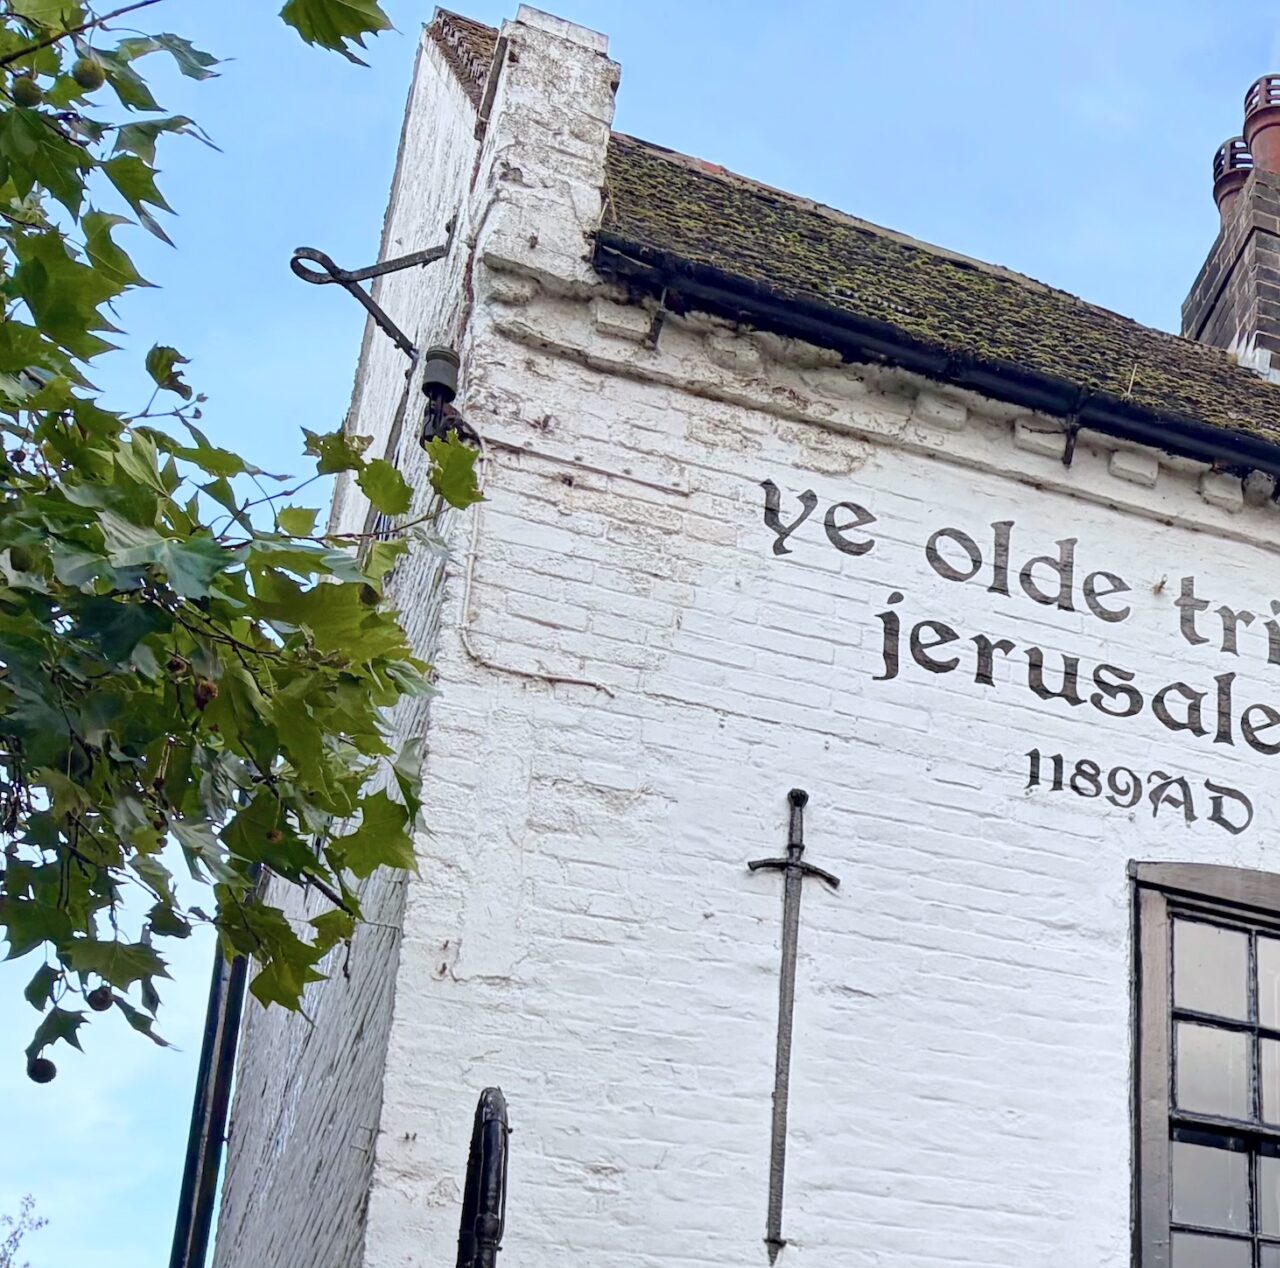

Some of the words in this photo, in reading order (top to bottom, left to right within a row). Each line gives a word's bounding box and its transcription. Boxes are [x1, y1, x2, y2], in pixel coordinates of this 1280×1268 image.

[759, 478, 877, 556] ye
[925, 520, 1132, 623] olde
[1024, 747, 1254, 835] 1189AD
